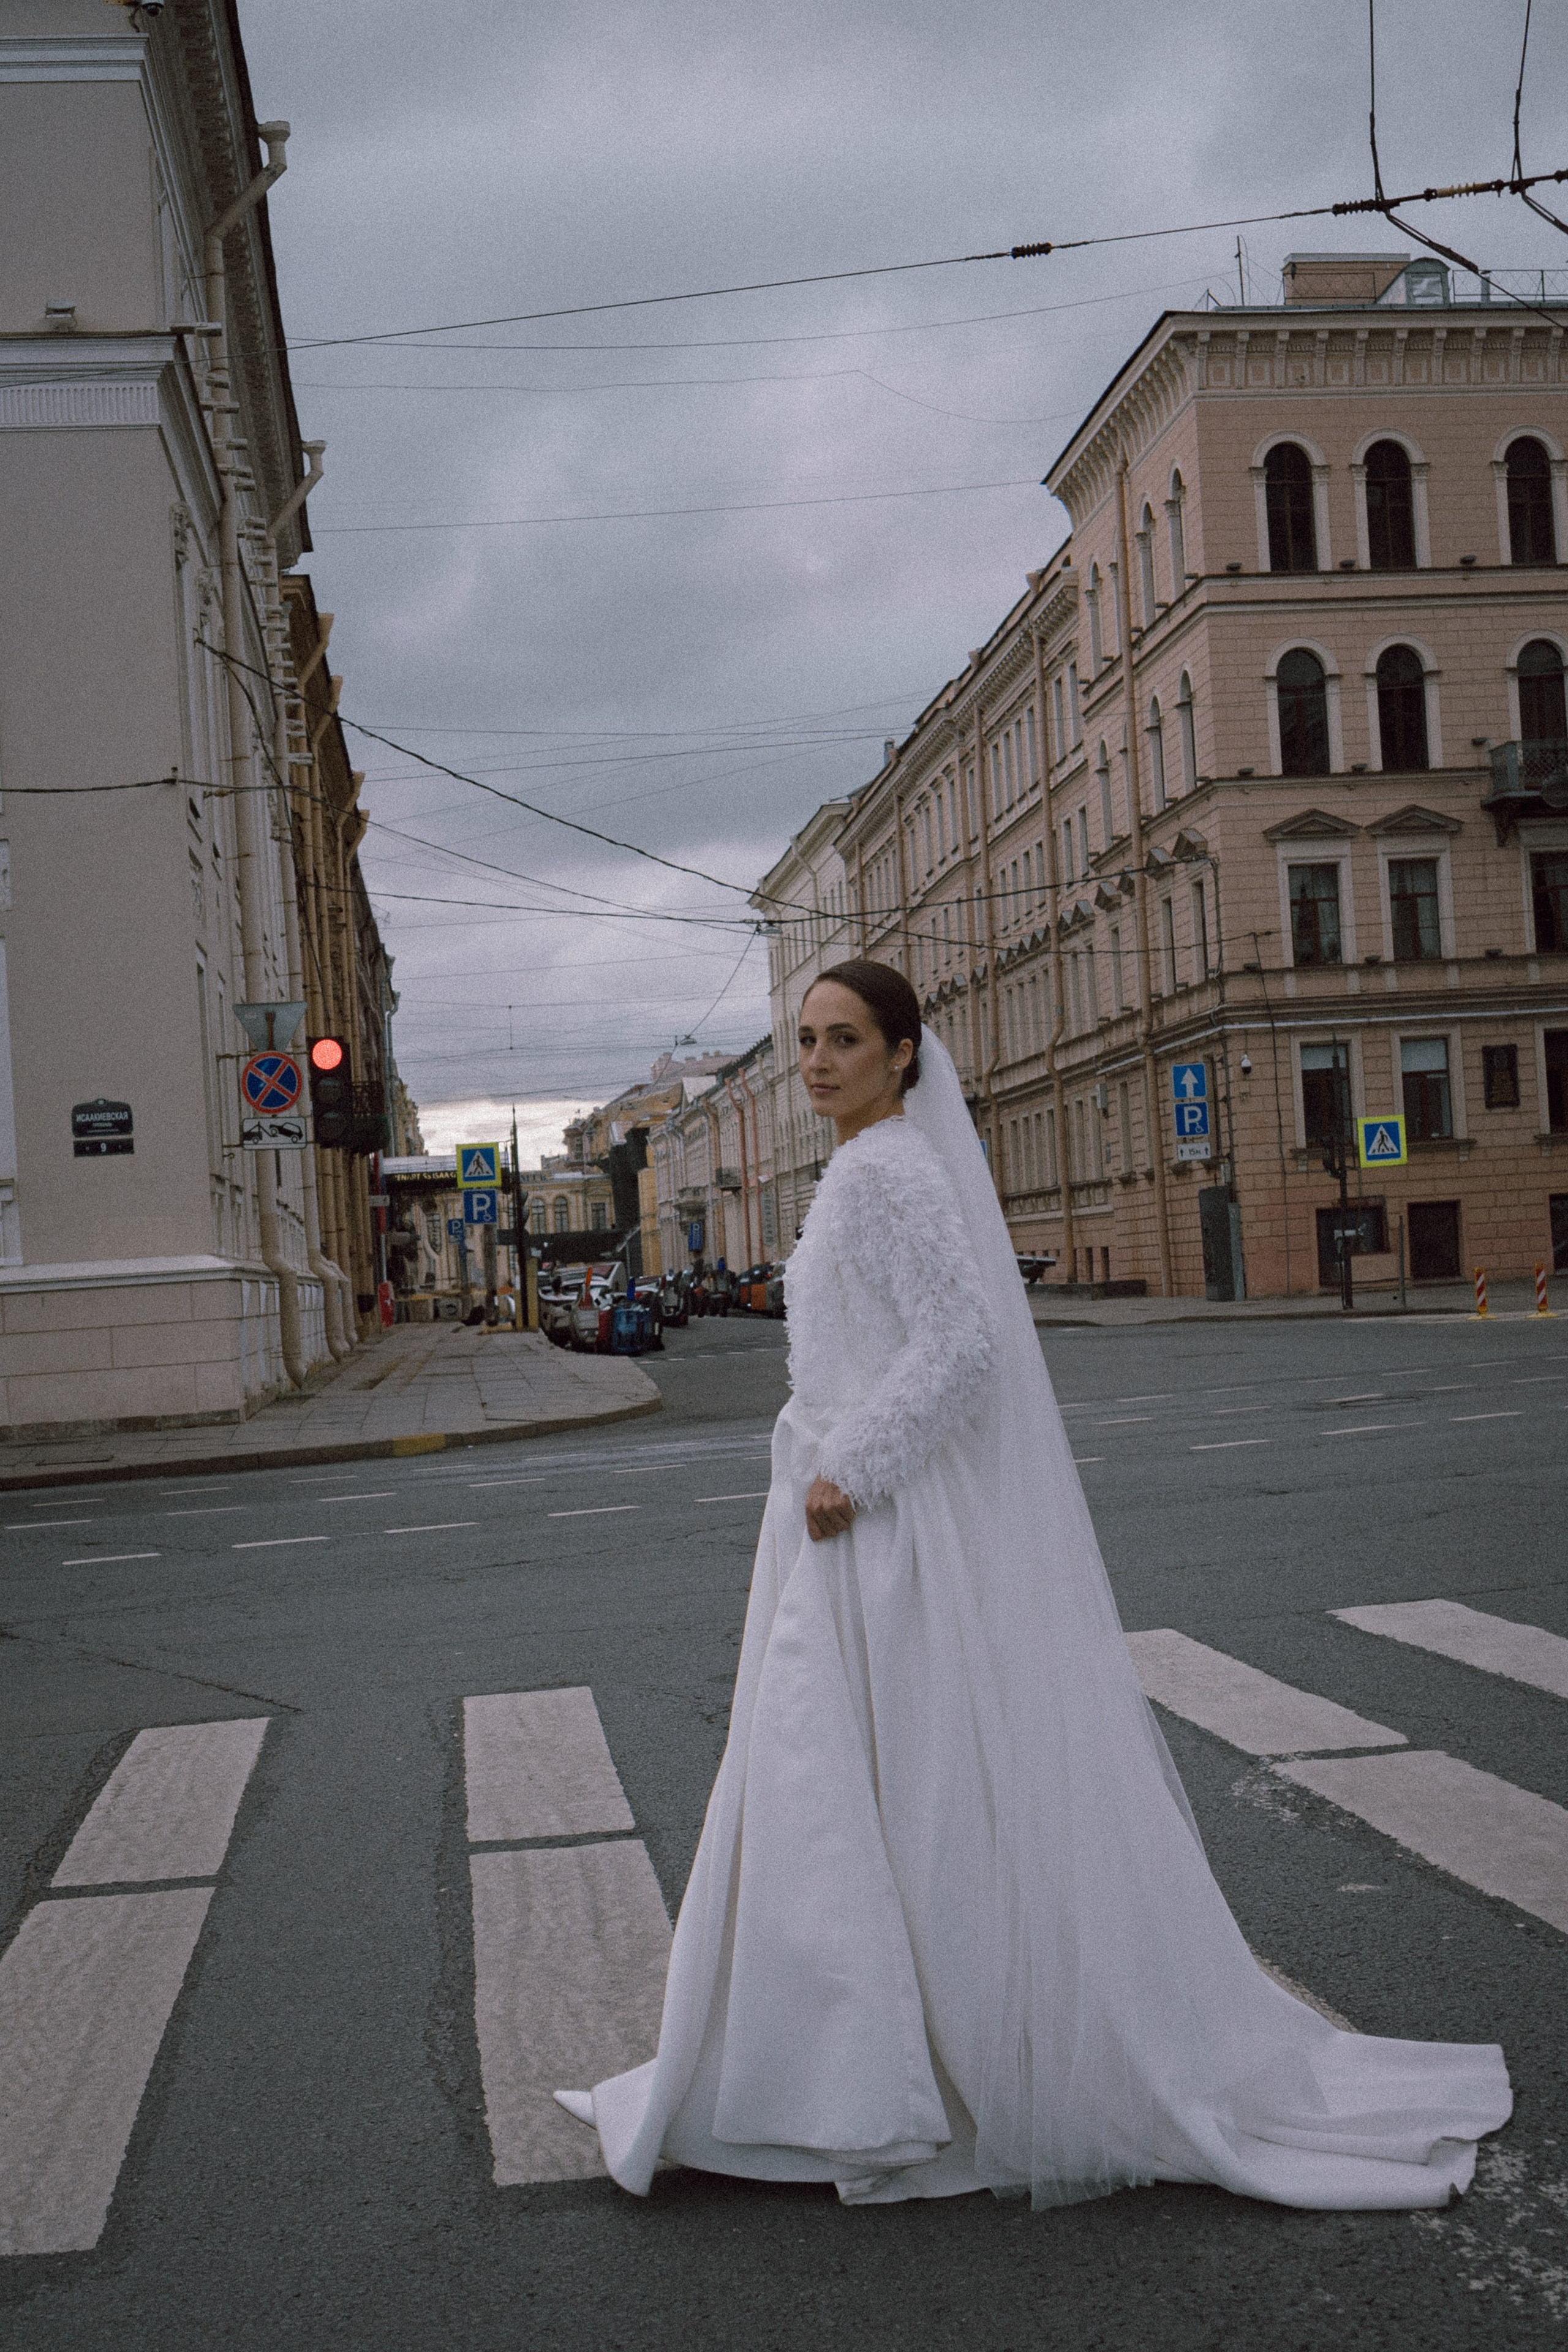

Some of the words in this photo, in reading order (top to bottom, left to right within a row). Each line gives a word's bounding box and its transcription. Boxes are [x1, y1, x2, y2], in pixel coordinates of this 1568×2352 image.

[75, 1111, 129, 1122] ИСААКИЕВСКАЯ
[1184, 1105, 1202, 1133] P
[100, 1142, 107, 1152] 9
[472, 1193, 491, 1220] P
